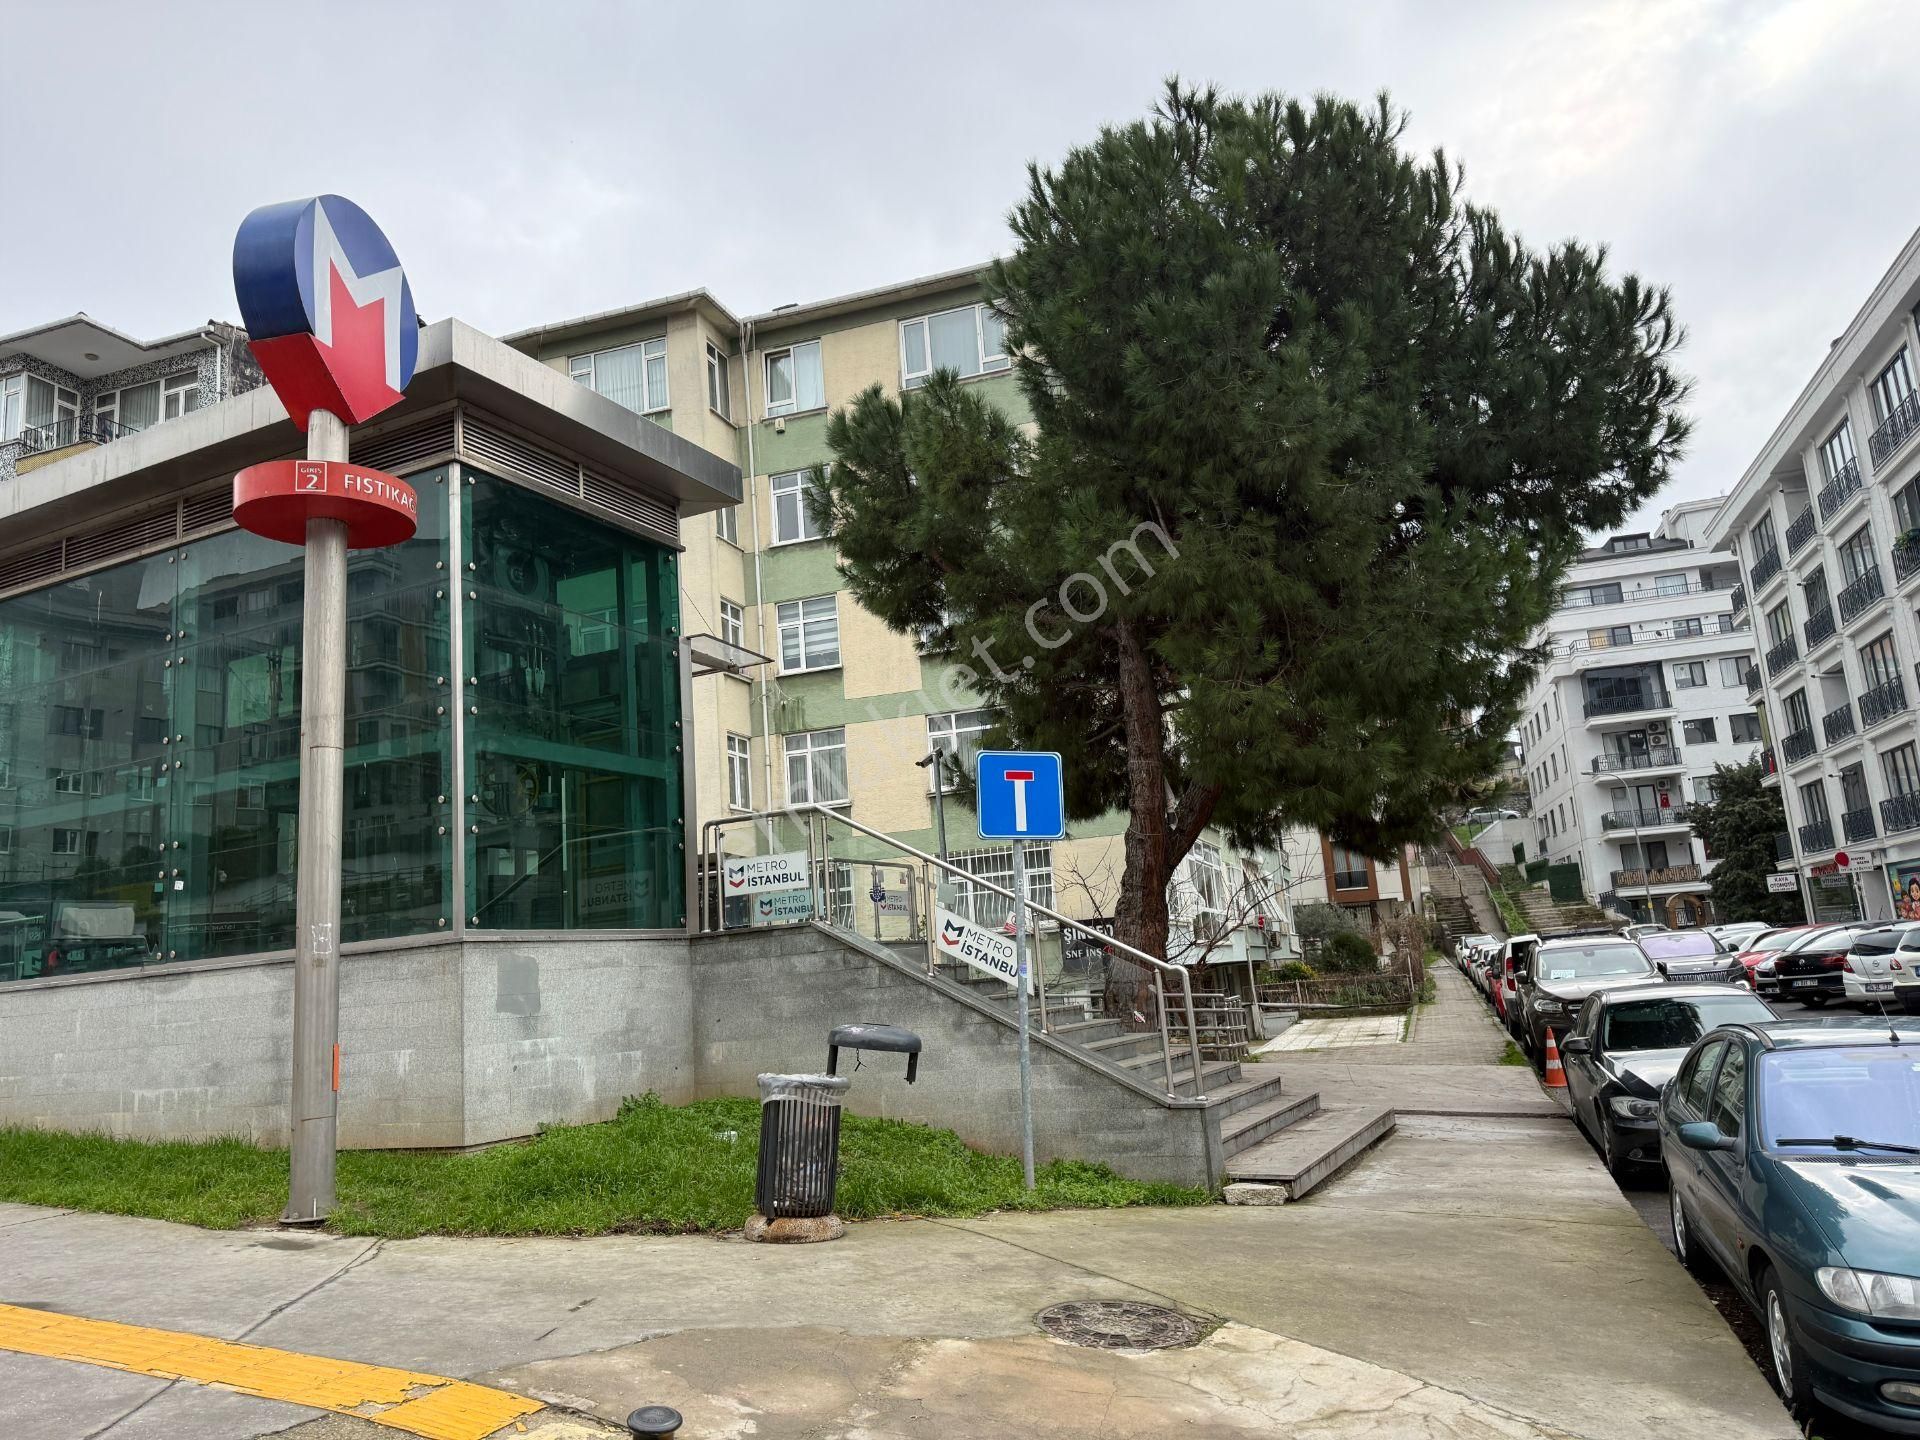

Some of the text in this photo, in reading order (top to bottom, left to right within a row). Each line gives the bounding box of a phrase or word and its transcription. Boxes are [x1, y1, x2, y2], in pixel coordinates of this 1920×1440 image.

[306, 474, 318, 489] 2
[344, 474, 416, 513] FISTIKAĞ
[747, 859, 788, 874] METRO
[748, 871, 804, 887] İSTANBUL
[774, 895, 806, 905] METRO
[774, 904, 813, 916] İSTANBU
[966, 928, 1013, 957] METRO
[961, 940, 1018, 977] İSTANBU
